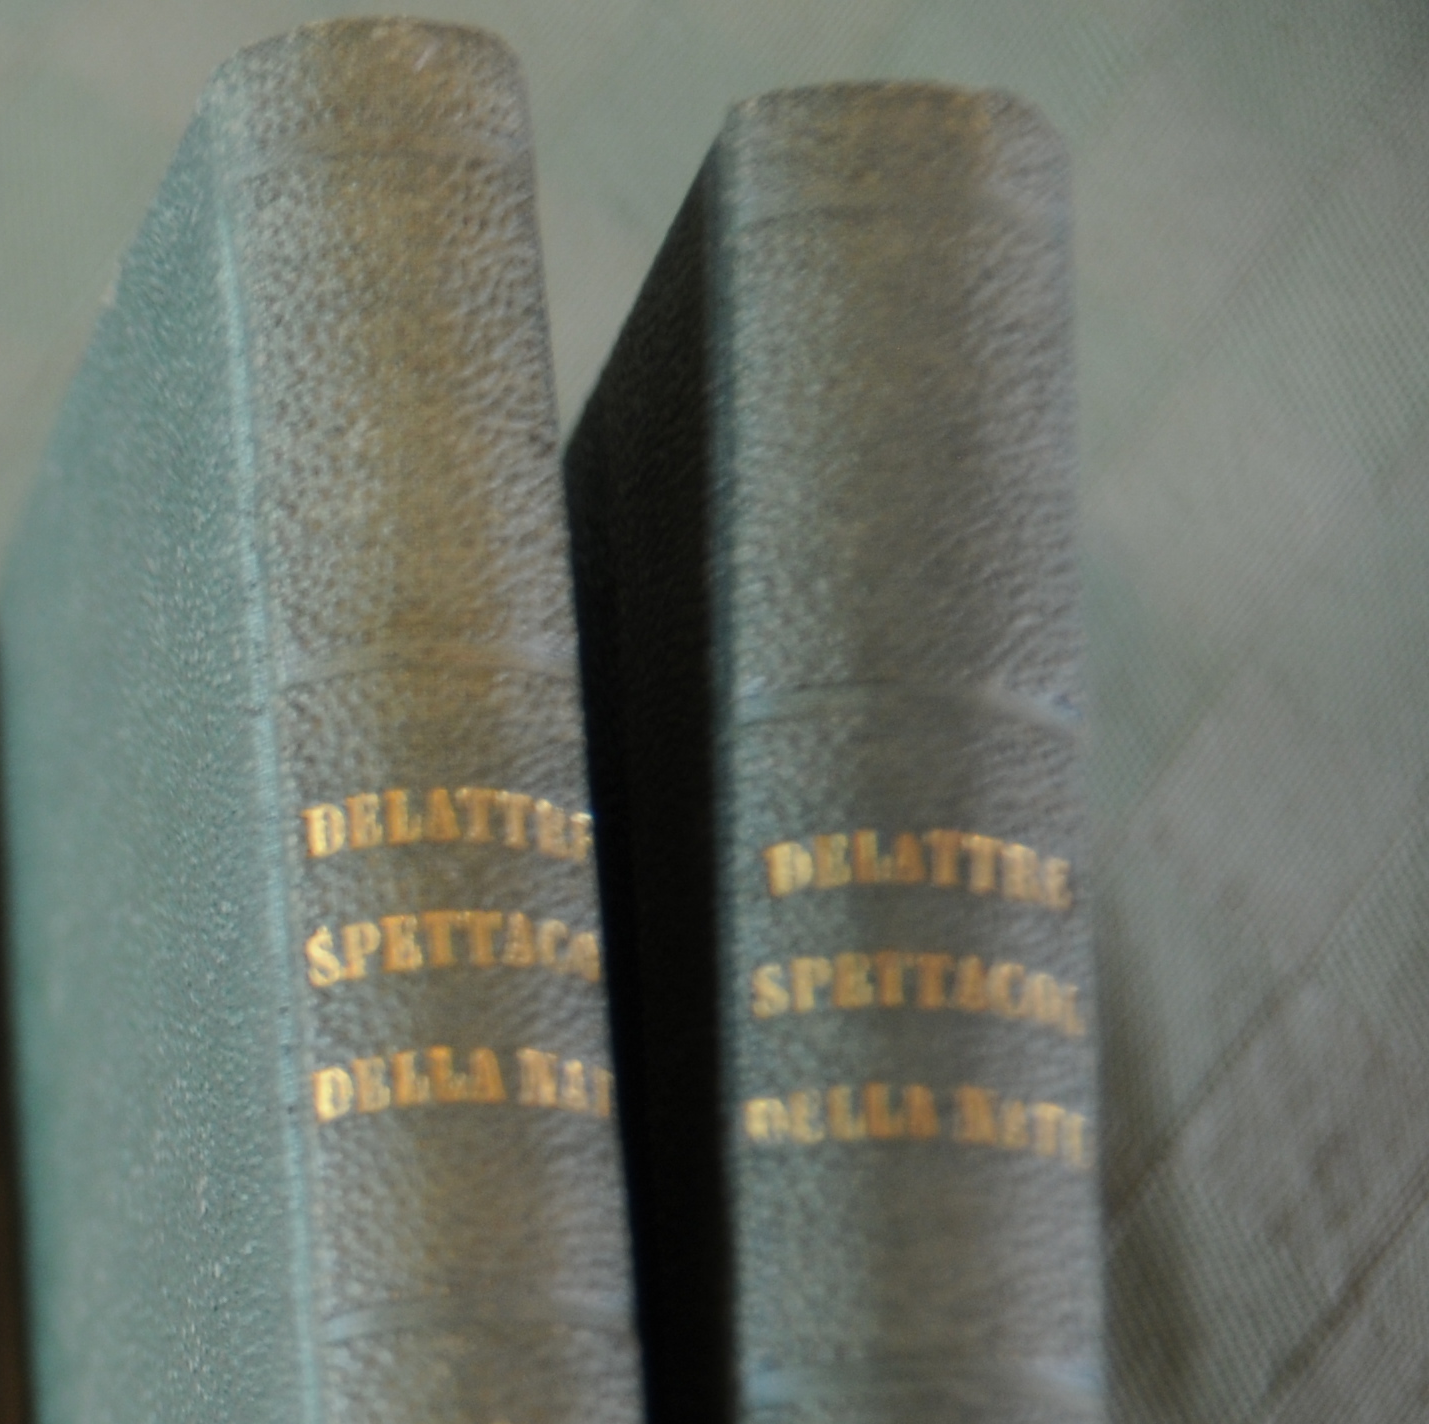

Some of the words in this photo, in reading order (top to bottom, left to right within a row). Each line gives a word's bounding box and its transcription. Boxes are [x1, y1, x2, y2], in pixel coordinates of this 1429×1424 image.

[762, 829, 1074, 912] DELATTRE
[311, 1046, 508, 1123] DELLA
[743, 1081, 939, 1147] DELLA
